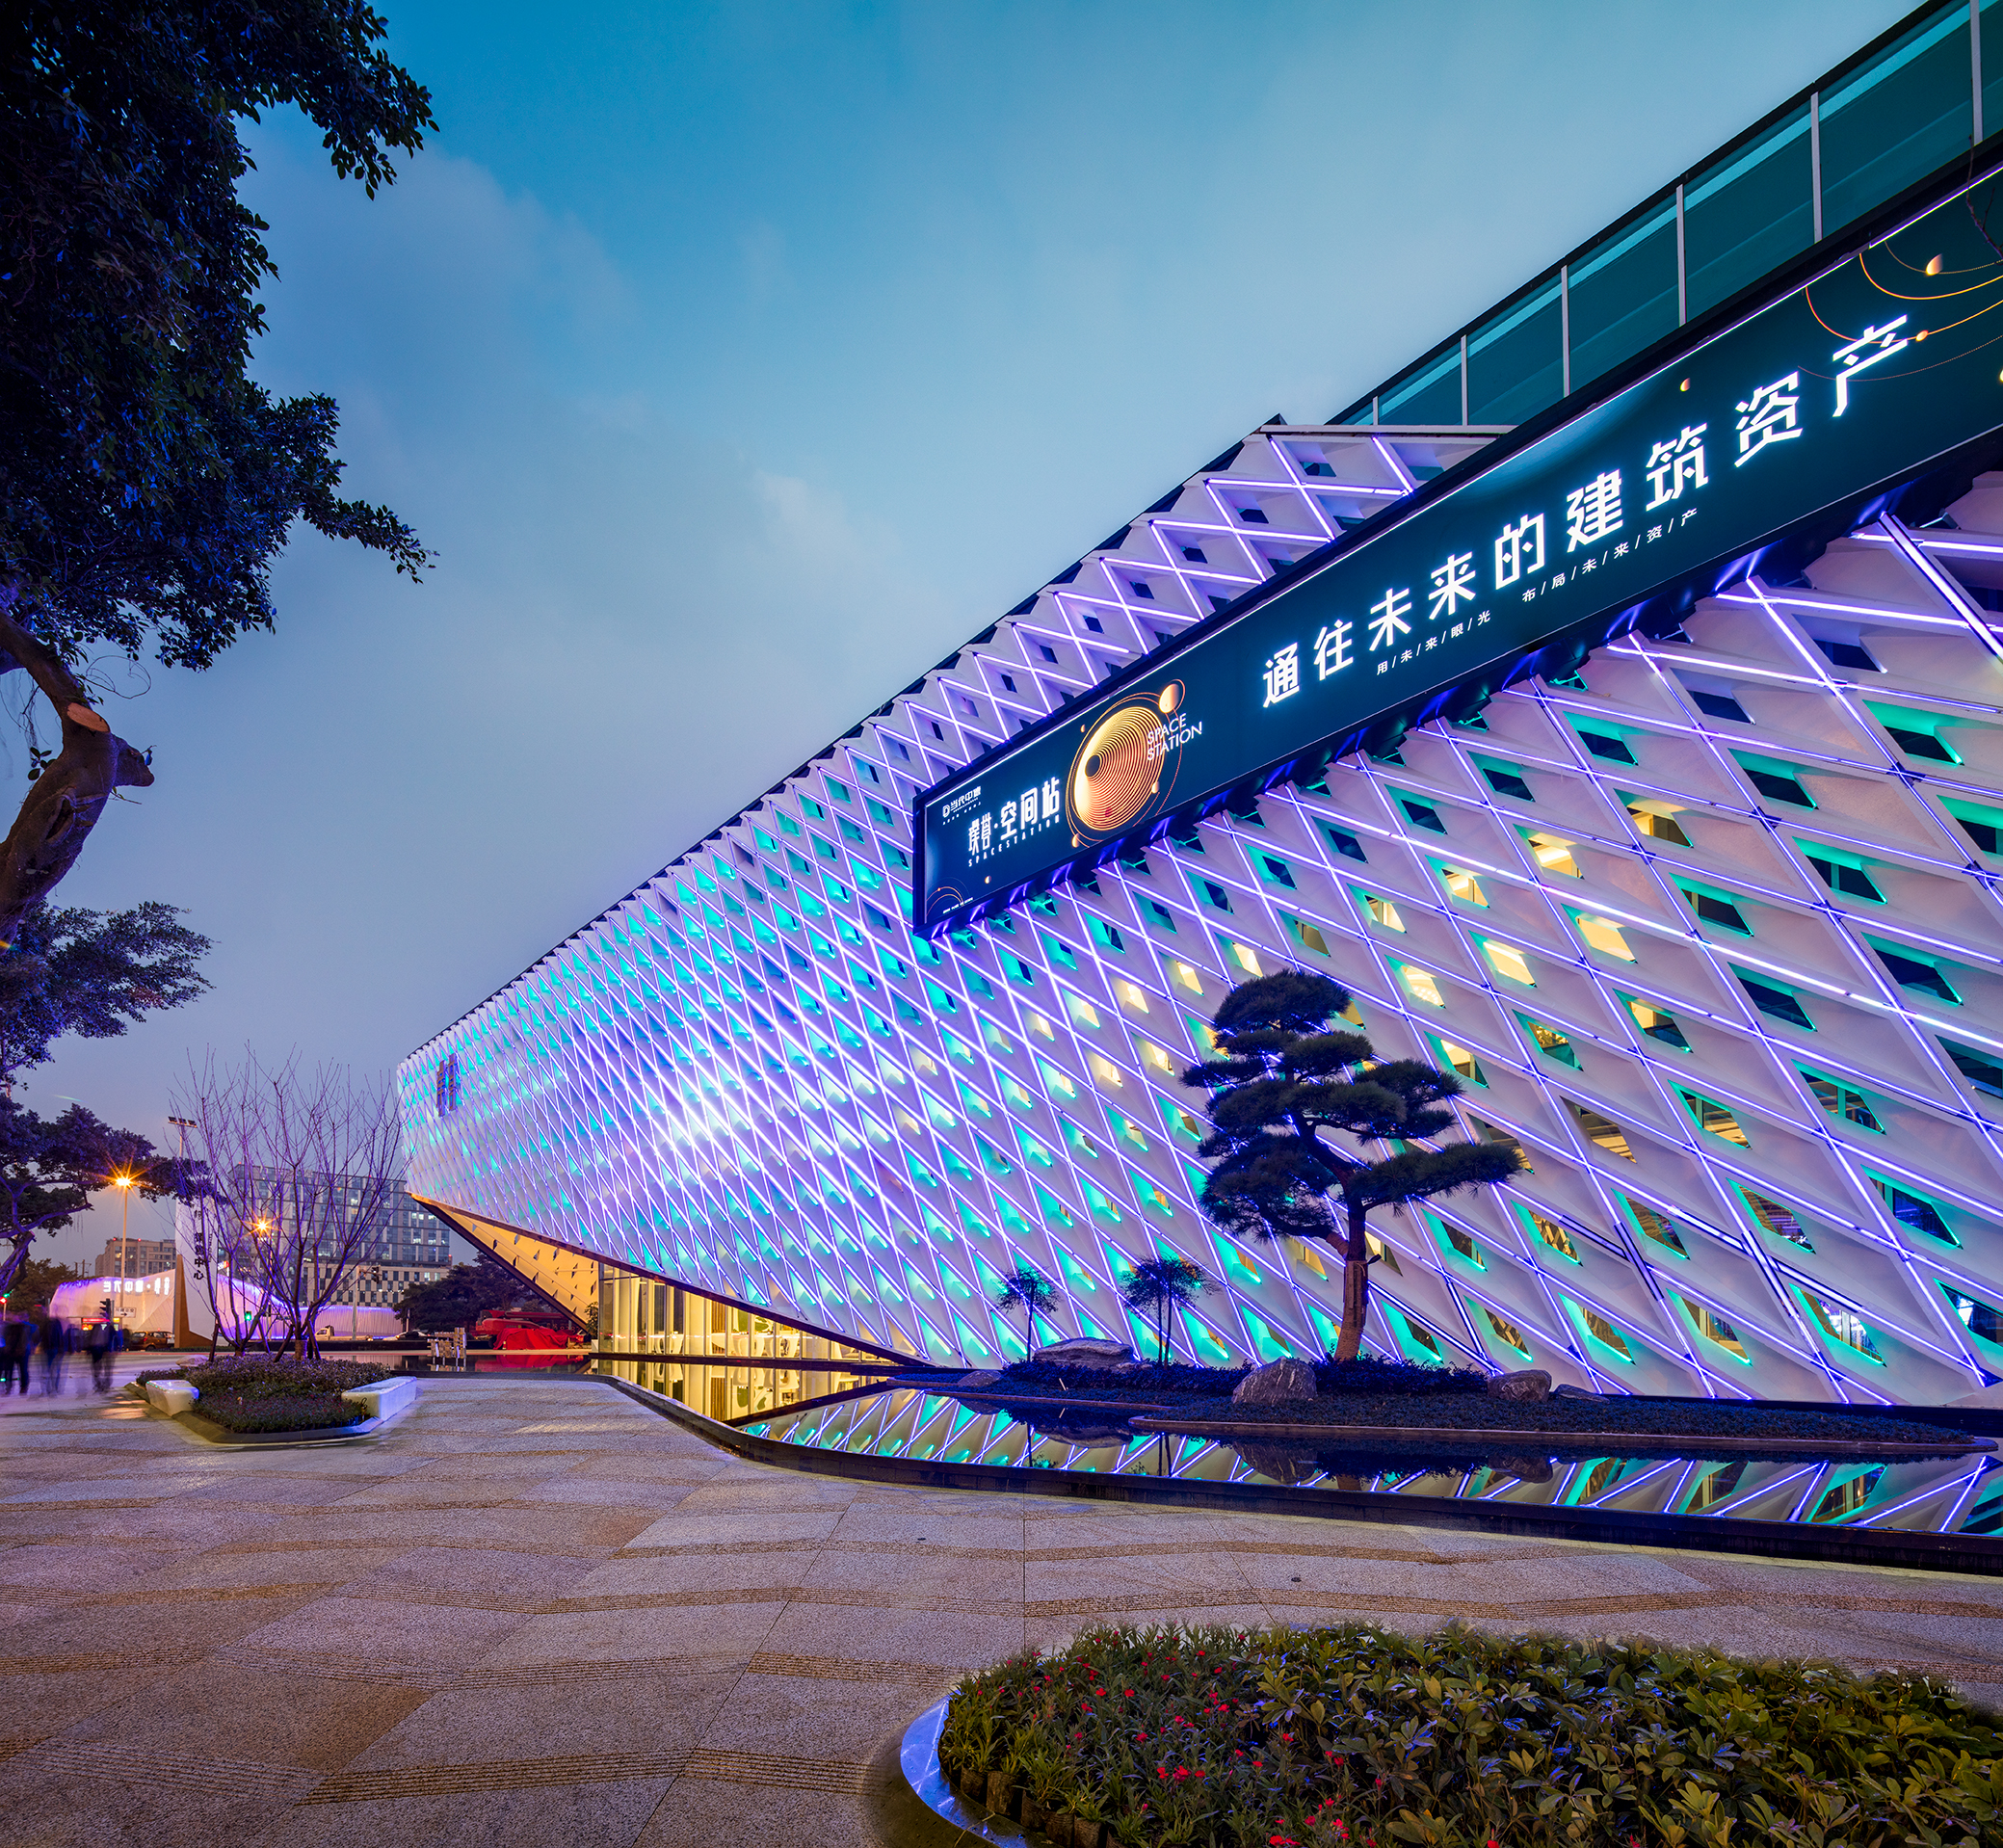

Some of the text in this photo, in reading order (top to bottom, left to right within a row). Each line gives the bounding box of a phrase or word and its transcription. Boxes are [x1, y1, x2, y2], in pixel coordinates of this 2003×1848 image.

[1262, 314, 1909, 709] 通往未来的建筑资产
[1146, 712, 1187, 745] SPACE
[1146, 721, 1202, 761] STATION
